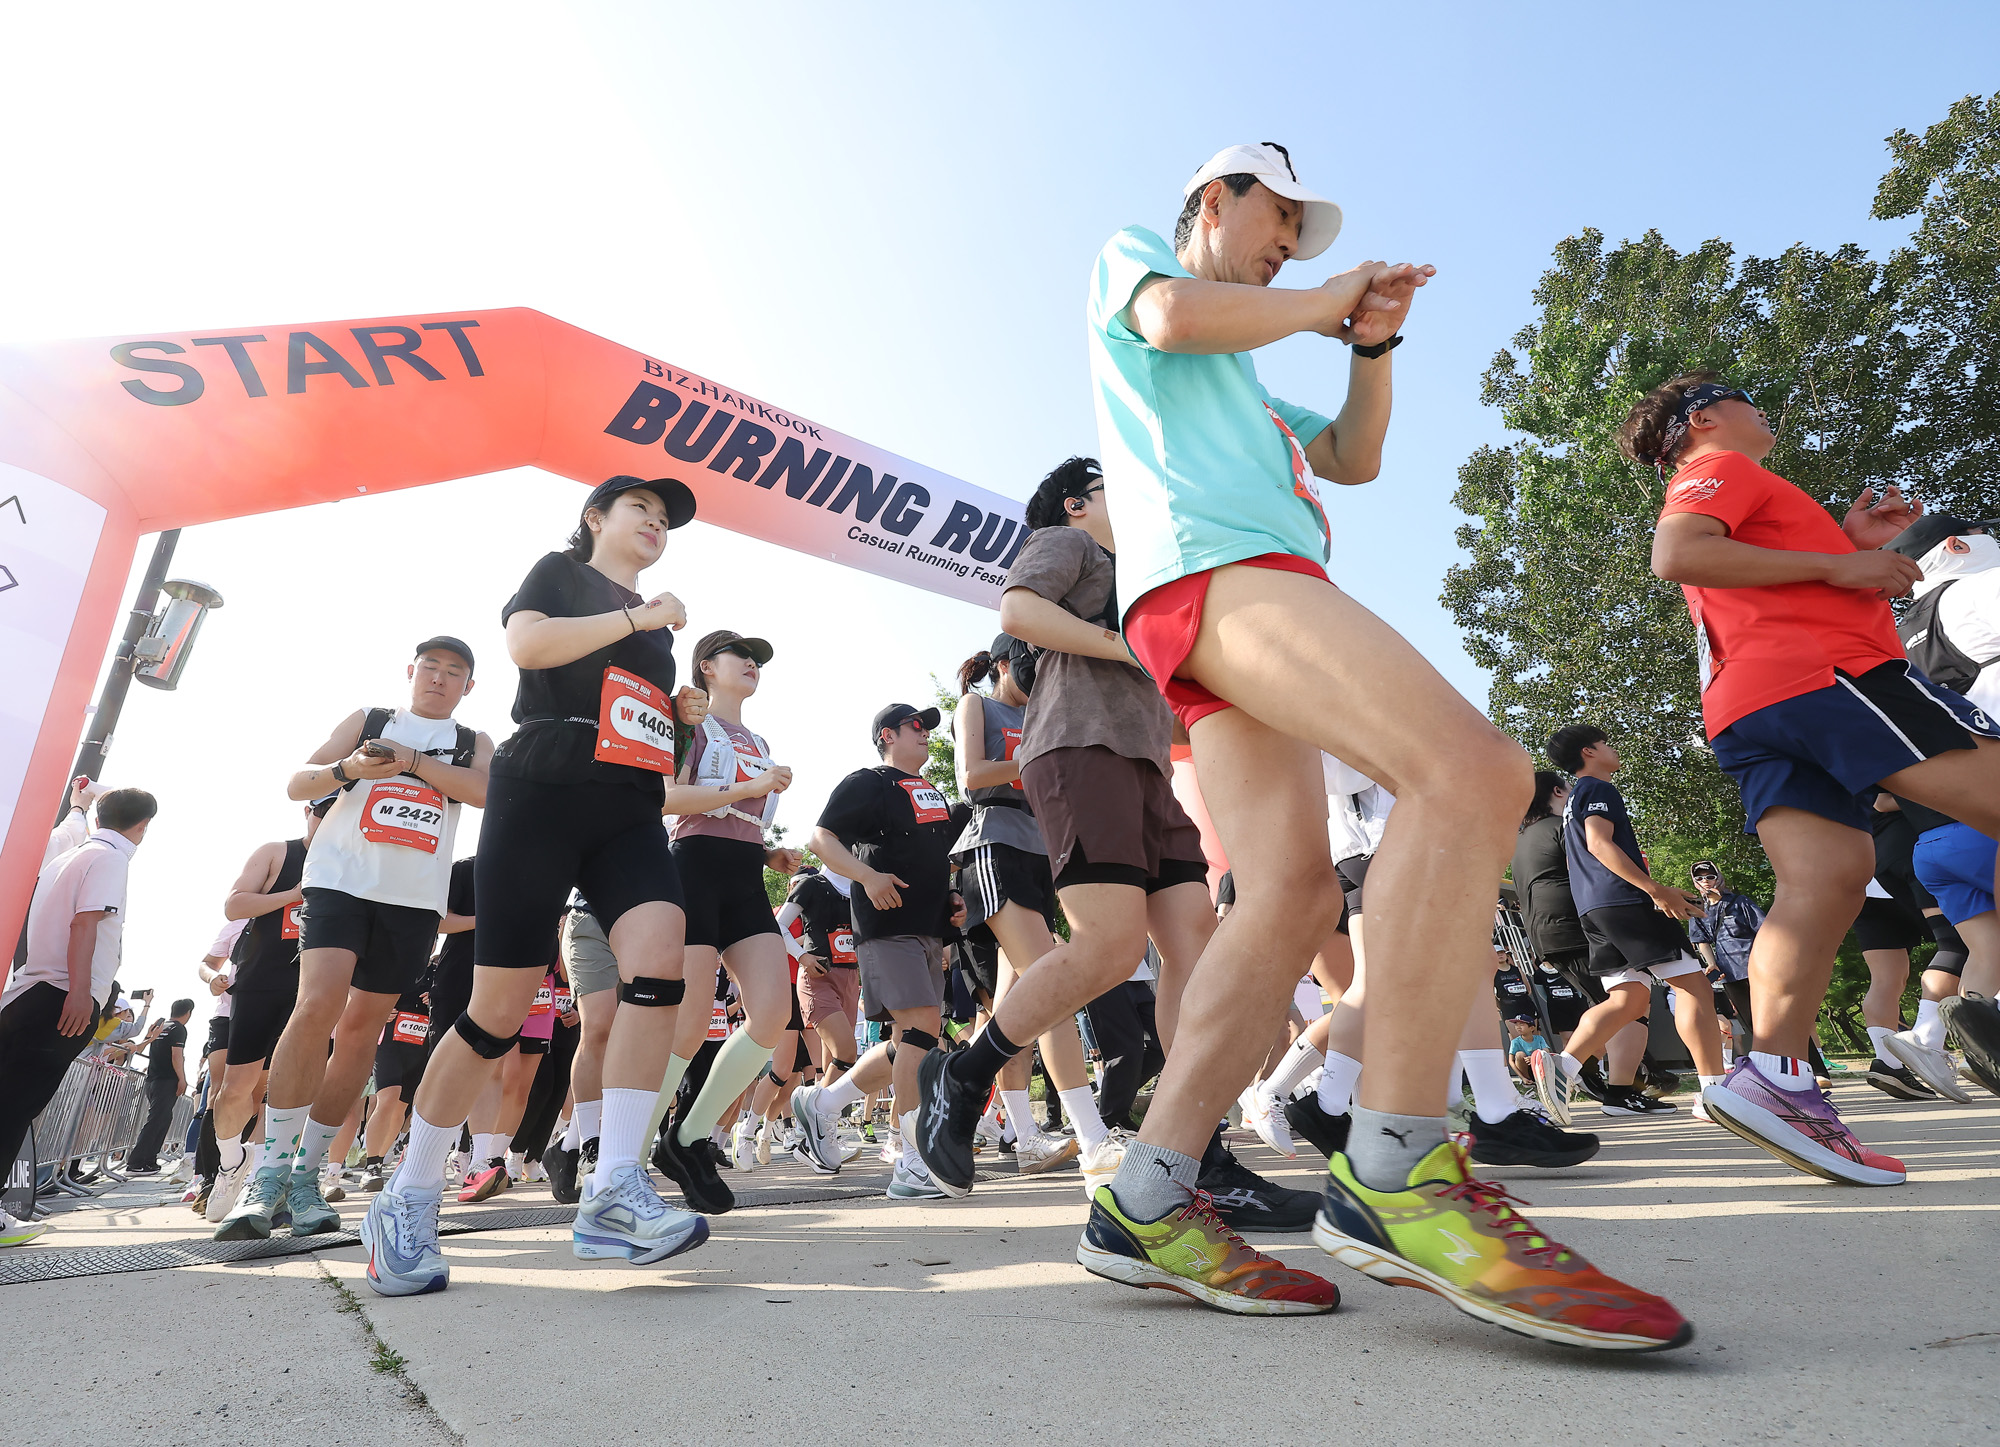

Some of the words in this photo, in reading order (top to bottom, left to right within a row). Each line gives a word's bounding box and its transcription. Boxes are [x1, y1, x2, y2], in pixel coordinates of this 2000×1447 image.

[110, 320, 484, 407] START
[603, 380, 930, 537] BURNING
[847, 525, 903, 555] Casual
[904, 544, 969, 579] Running
[969, 565, 1007, 587] Festi
[607, 672, 640, 690] BURNING
[639, 684, 652, 697] RUN
[620, 706, 634, 722] W
[637, 711, 674, 741] 4403
[374, 785, 405, 793] BURNING
[404, 788, 421, 796] RUN
[916, 793, 924, 801] M
[379, 805, 394, 815] M
[396, 805, 442, 825] 2427
[408, 1023, 428, 1033] 1003
